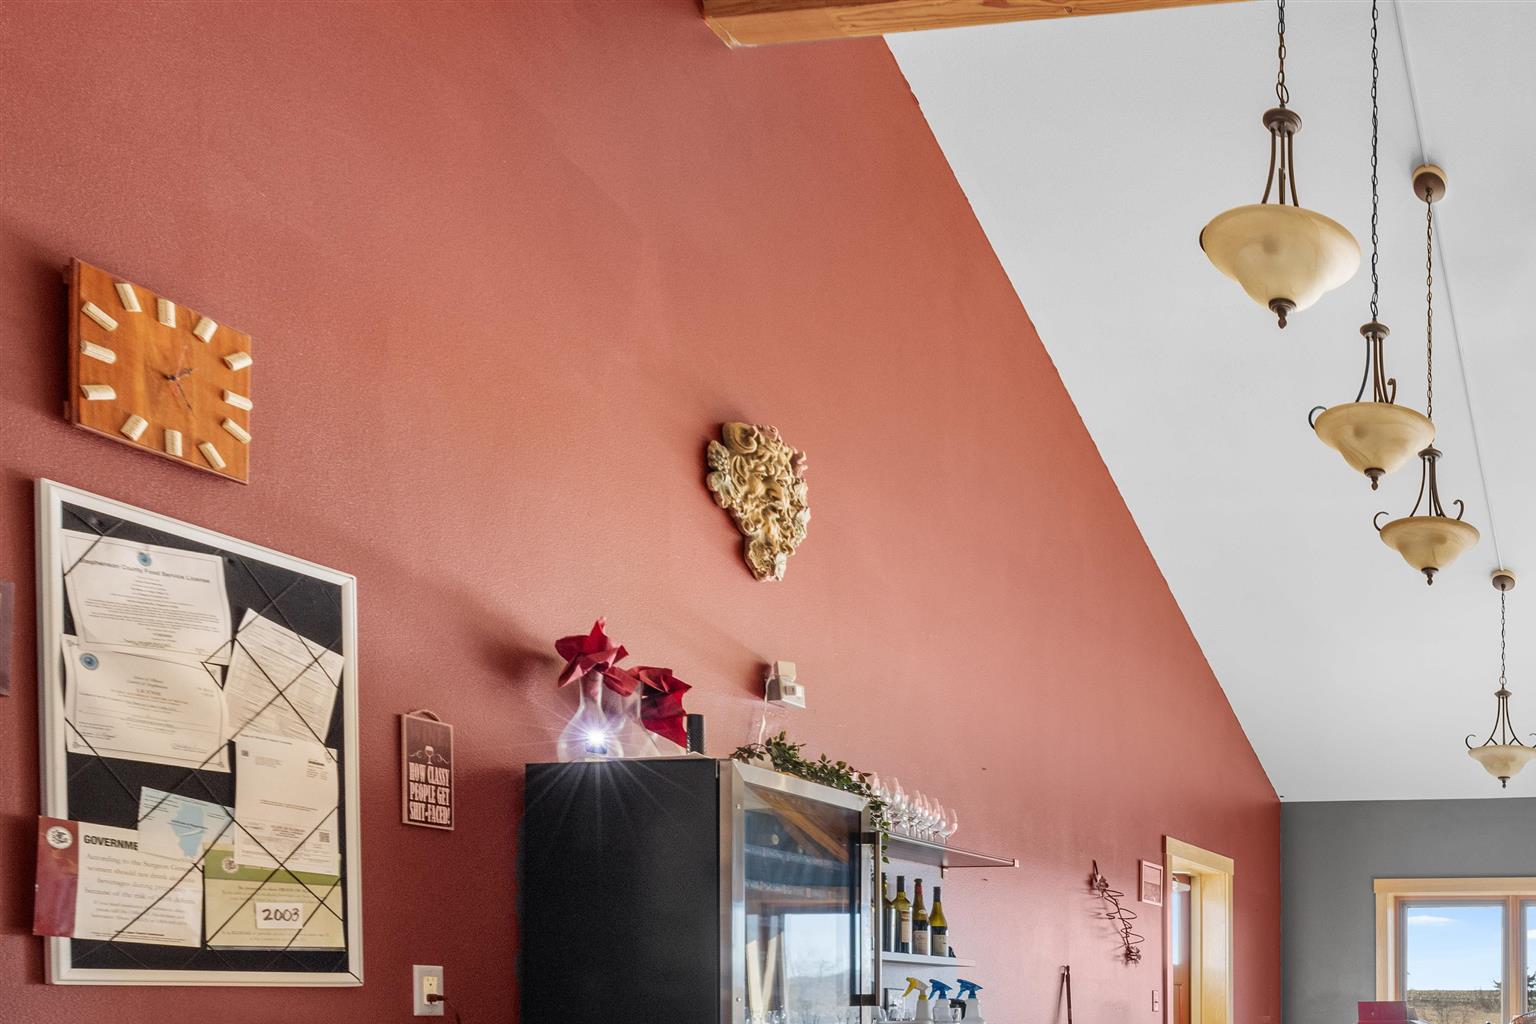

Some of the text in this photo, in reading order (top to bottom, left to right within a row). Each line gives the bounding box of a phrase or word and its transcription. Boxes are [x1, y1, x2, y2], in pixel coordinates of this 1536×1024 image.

[408, 761, 450, 787] HOW CLASSY
[409, 781, 450, 806] PEOPLE GET
[409, 801, 450, 825] SHIT-FACED!
[83, 834, 139, 851] GOVERNME
[262, 908, 300, 921] 2003
